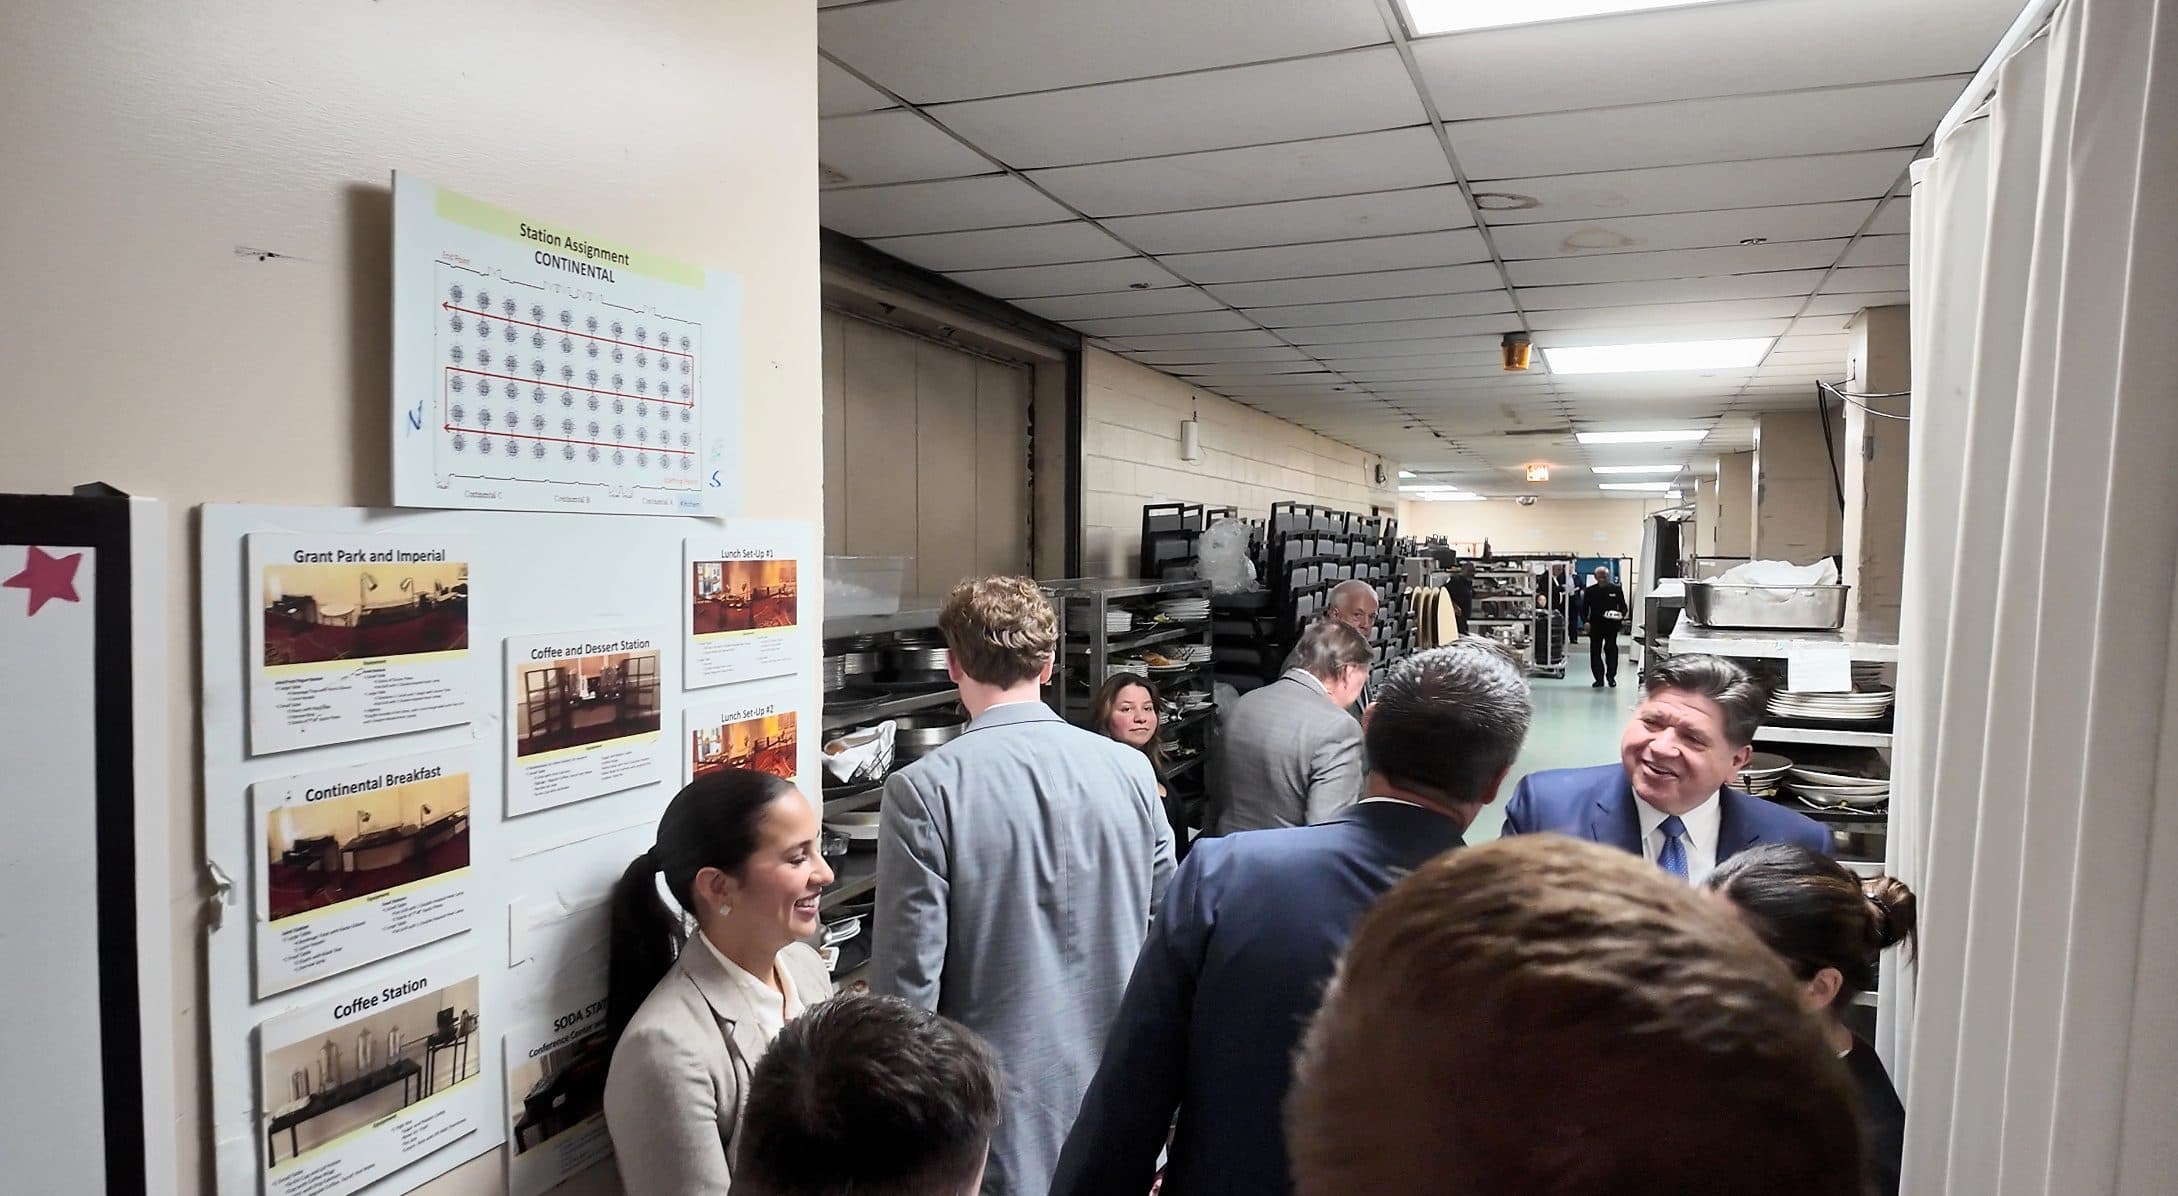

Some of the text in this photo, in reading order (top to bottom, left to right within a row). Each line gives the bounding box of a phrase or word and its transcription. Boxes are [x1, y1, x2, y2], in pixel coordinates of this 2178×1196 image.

[520, 223, 630, 266] Station Assignment
[535, 250, 615, 283] CONTINENTAL
[293, 548, 446, 564] Grant Park and Imperial
[721, 548, 741, 559] Lunch
[742, 548, 765, 560] Set-Up
[531, 639, 650, 660] Coffee and Dessert Station
[721, 710, 742, 722] Lunch
[742, 706, 765, 719] Set-Up
[305, 766, 442, 802] Continental Breakfast
[333, 977, 428, 1020] Coffee Station
[553, 1008, 583, 1032] SODA
[528, 1035, 569, 1058] Conference
